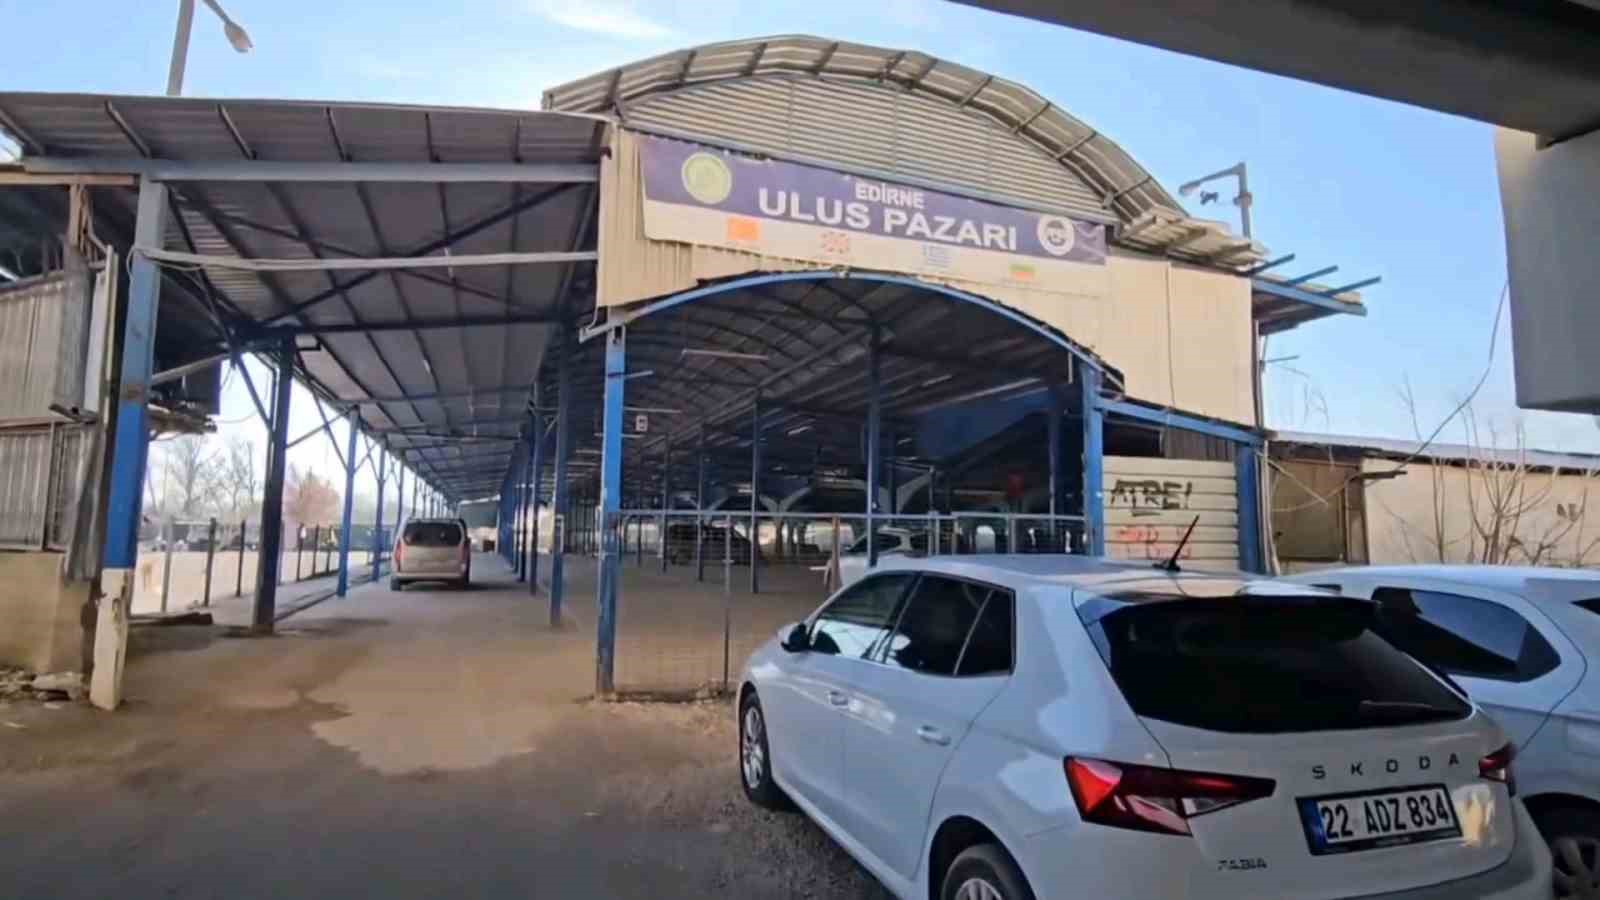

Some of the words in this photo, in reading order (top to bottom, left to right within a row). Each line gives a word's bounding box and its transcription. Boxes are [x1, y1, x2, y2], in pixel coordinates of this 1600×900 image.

[759, 187, 870, 230] ULUS
[883, 207, 1017, 251] PAZARI
[1321, 804, 1353, 838] 22
[1364, 798, 1407, 834] ADZ
[1406, 791, 1449, 827] 834
